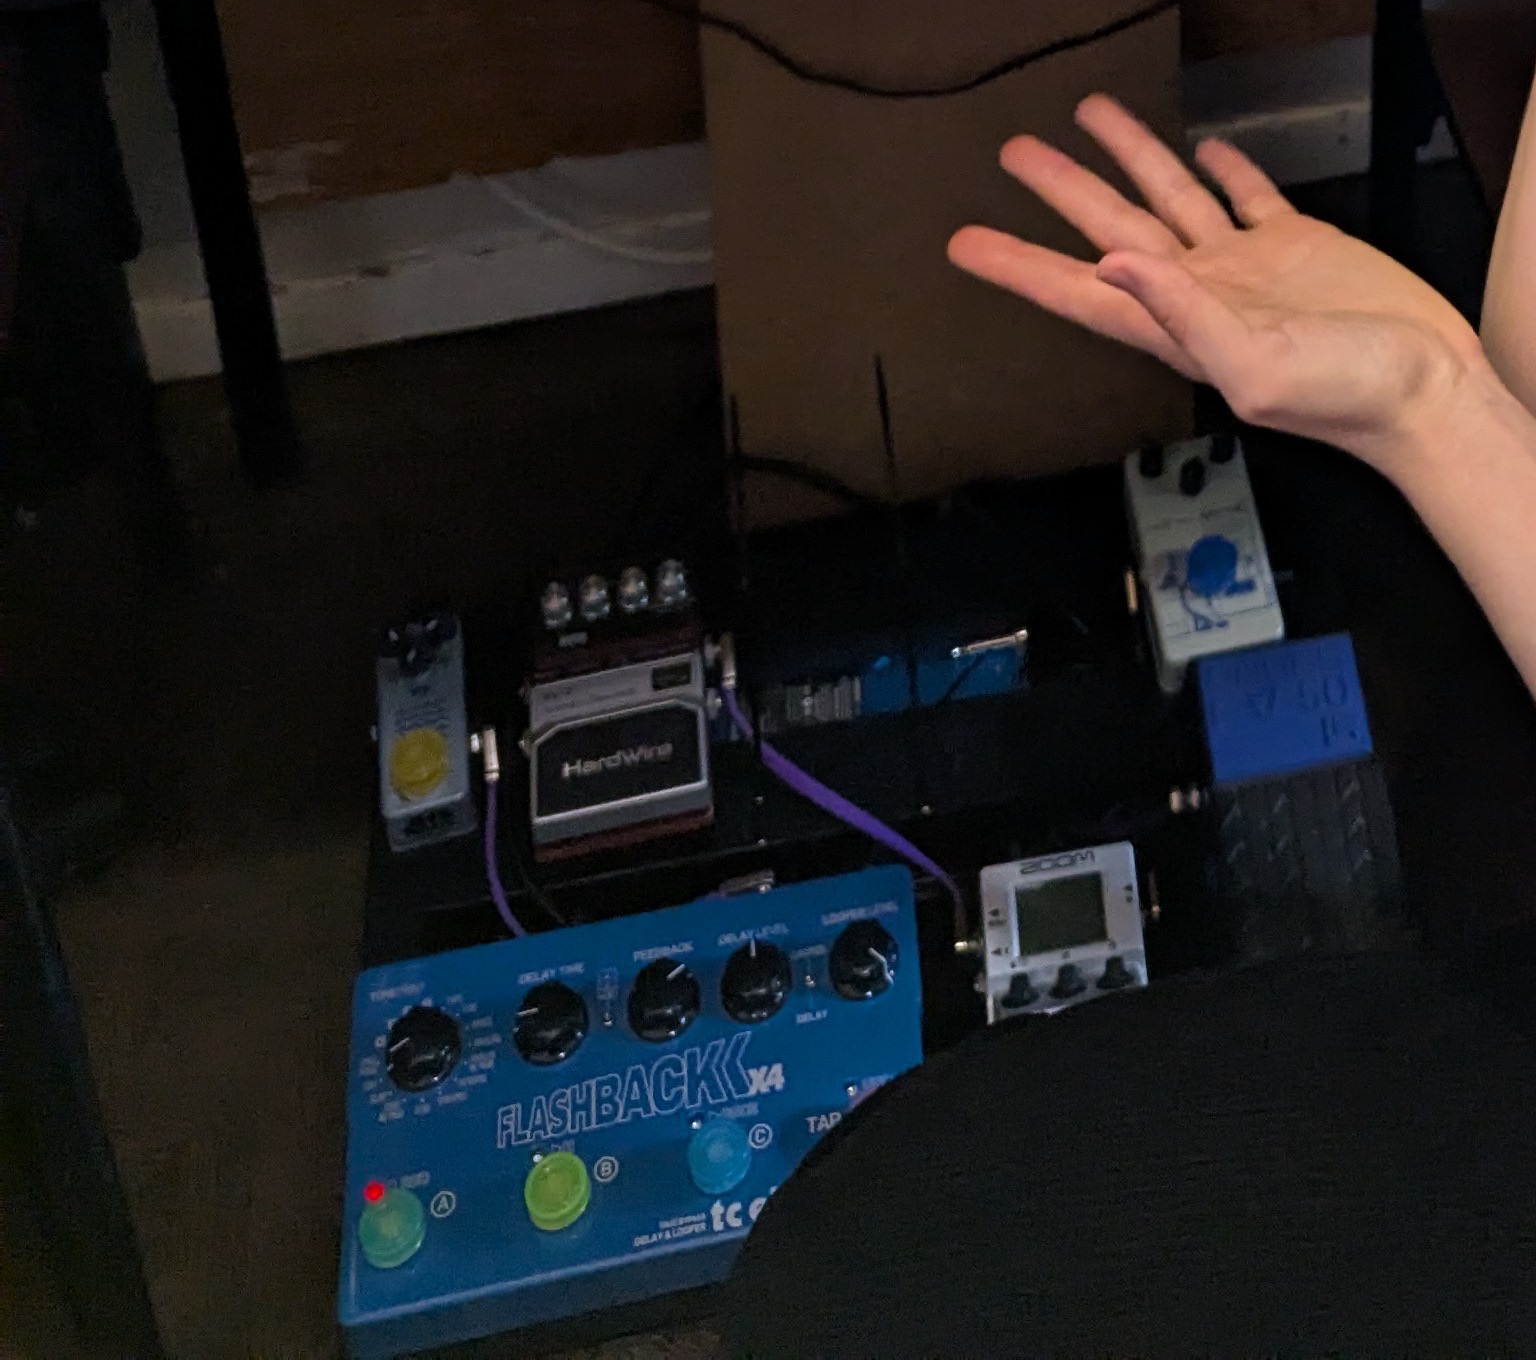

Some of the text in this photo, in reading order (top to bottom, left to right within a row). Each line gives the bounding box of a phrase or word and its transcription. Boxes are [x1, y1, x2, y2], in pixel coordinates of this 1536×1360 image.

[561, 742, 675, 779] HardWire
[1019, 848, 1097, 875] ZOOM
[632, 940, 694, 962] FEEDBACK
[517, 968, 556, 985] DELAY
[497, 1031, 752, 1149] FLASHBACK
[805, 1111, 843, 1134] TAP
[709, 1198, 743, 1232] tc
